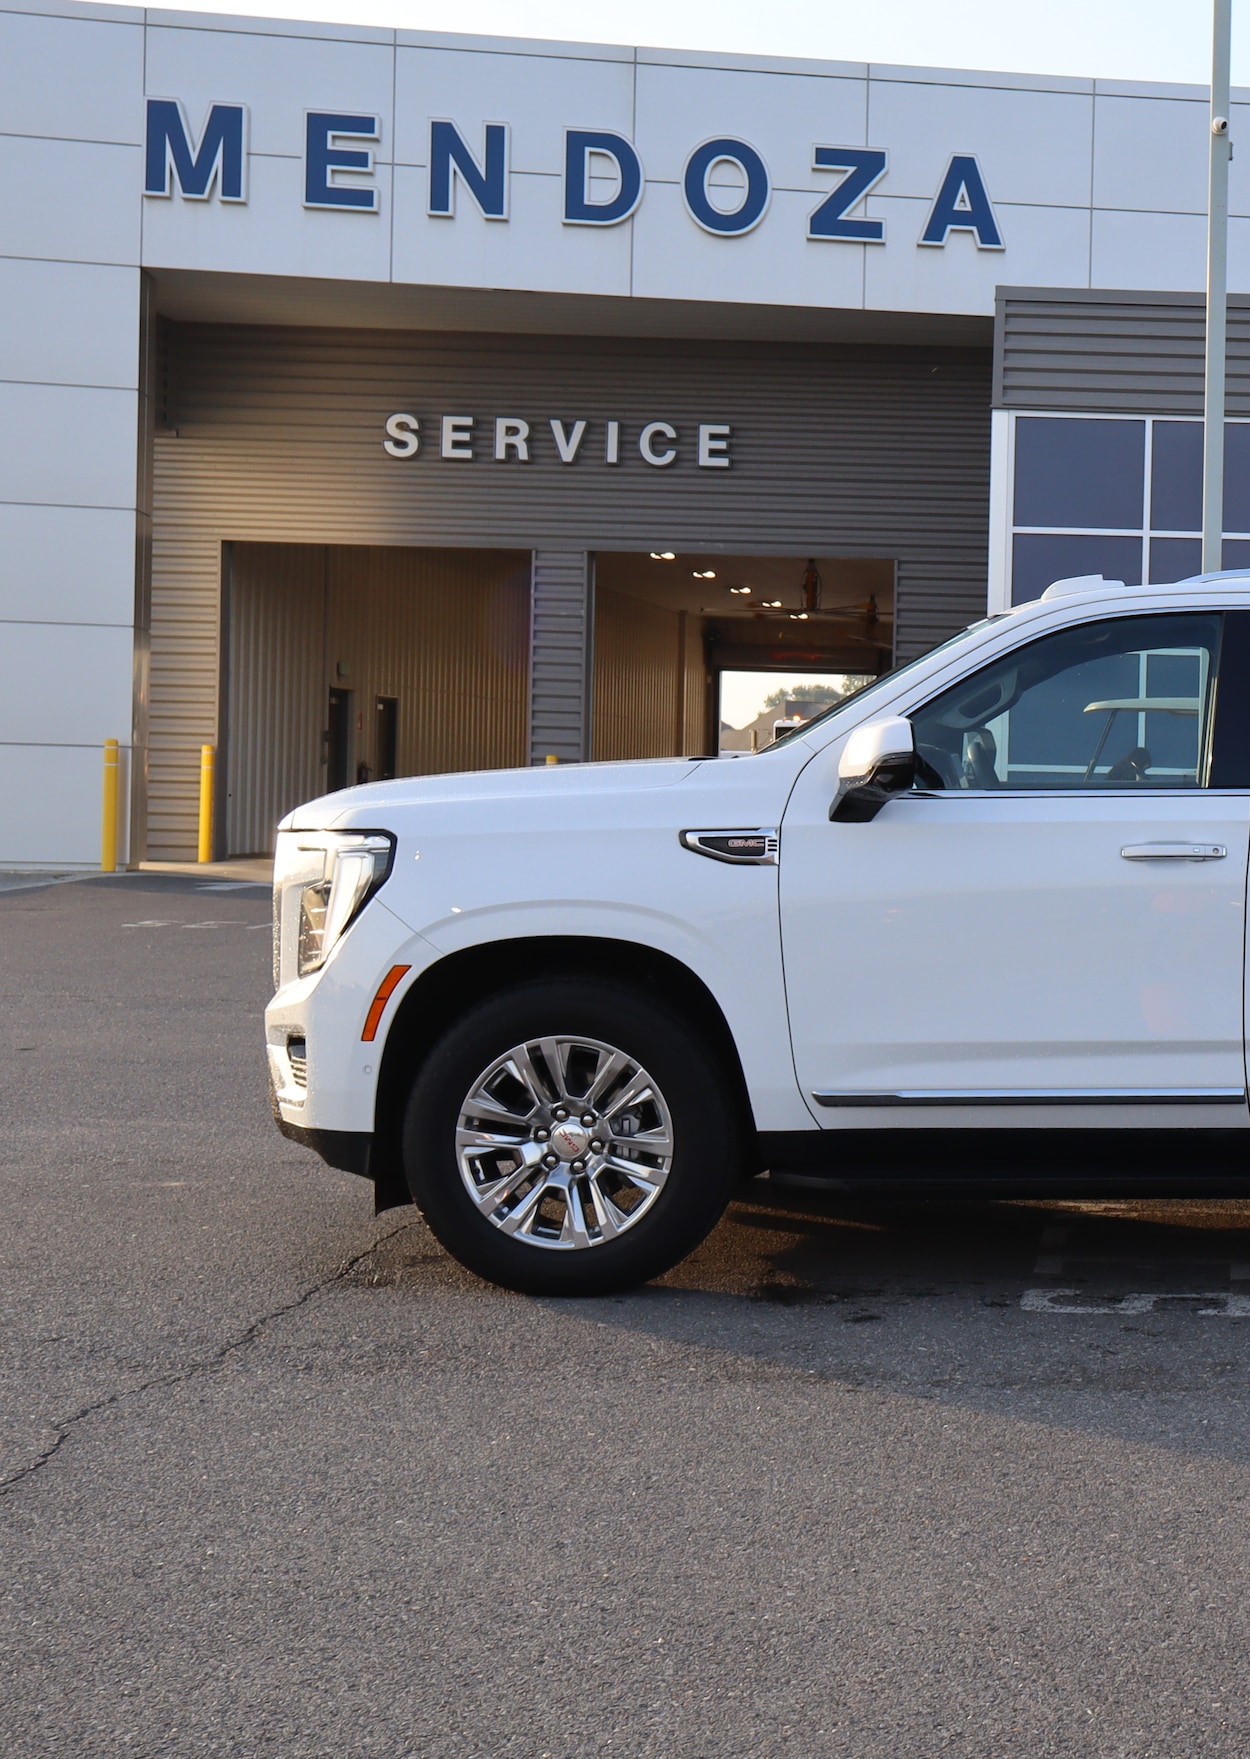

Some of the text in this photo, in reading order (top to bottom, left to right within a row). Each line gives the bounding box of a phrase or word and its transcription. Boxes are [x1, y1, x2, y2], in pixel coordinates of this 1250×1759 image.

[143, 97, 1005, 250] MENDOZA
[383, 412, 732, 469] SERVICE
[727, 839, 765, 848] GMC
[559, 1129, 580, 1153] GMC
